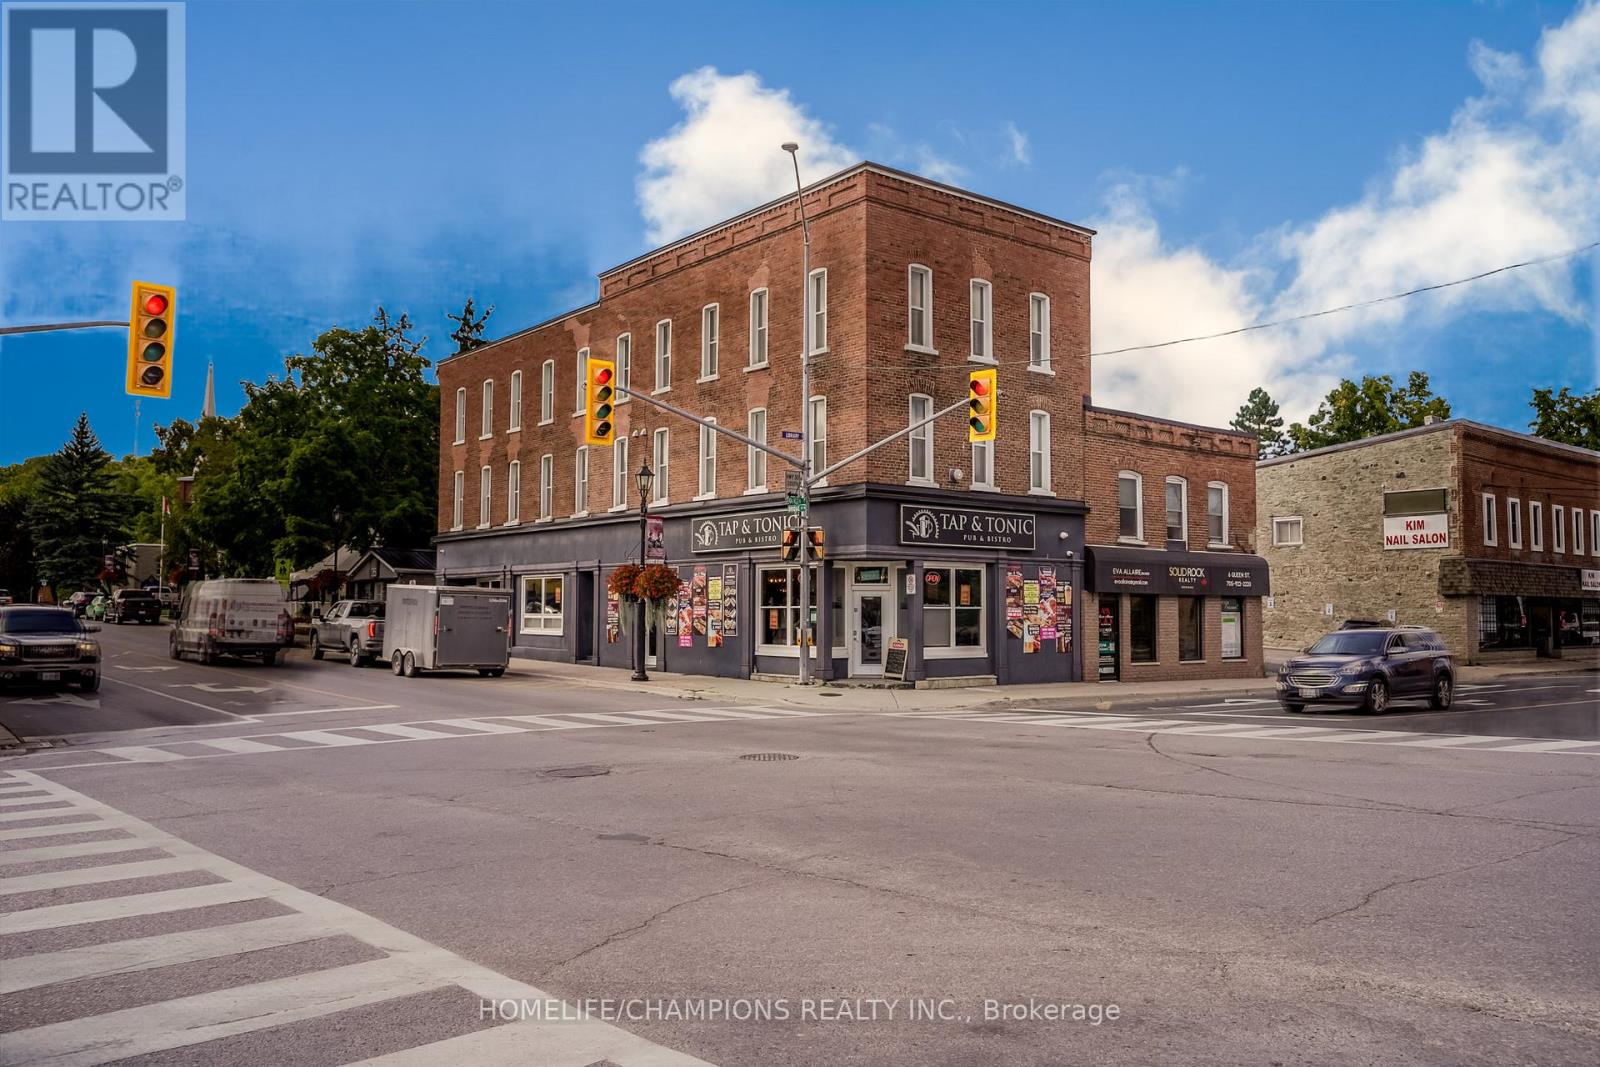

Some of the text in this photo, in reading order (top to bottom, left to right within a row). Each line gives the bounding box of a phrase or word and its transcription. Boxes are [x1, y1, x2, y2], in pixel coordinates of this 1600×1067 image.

[718, 520, 739, 537] TAP
[741, 519, 751, 535] &
[940, 513, 1033, 535] TAP & TONIC
[1405, 519, 1425, 531] KIM
[735, 537, 747, 545] PUB
[754, 535, 778, 543] BISTRO
[963, 534, 977, 542] PUB
[987, 536, 1012, 544] BISTRO
[1385, 532, 1448, 546] NAIL SALON
